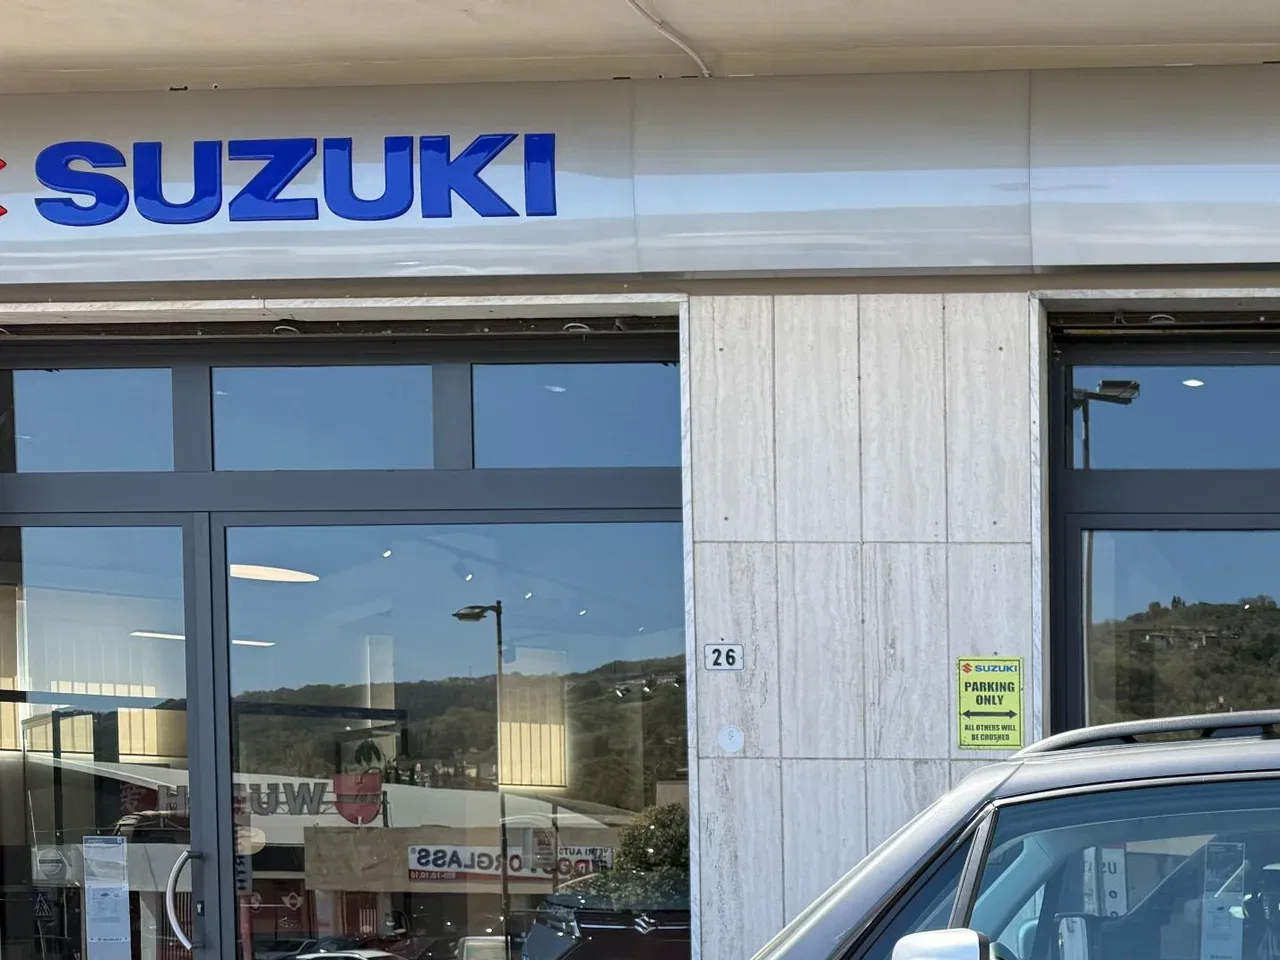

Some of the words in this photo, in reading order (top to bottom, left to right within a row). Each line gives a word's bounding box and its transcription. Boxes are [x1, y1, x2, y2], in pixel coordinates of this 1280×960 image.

[34, 133, 557, 227] SUZUKI
[712, 648, 736, 667] 26
[964, 681, 1015, 692] PARKING
[976, 695, 1004, 705] ONLY
